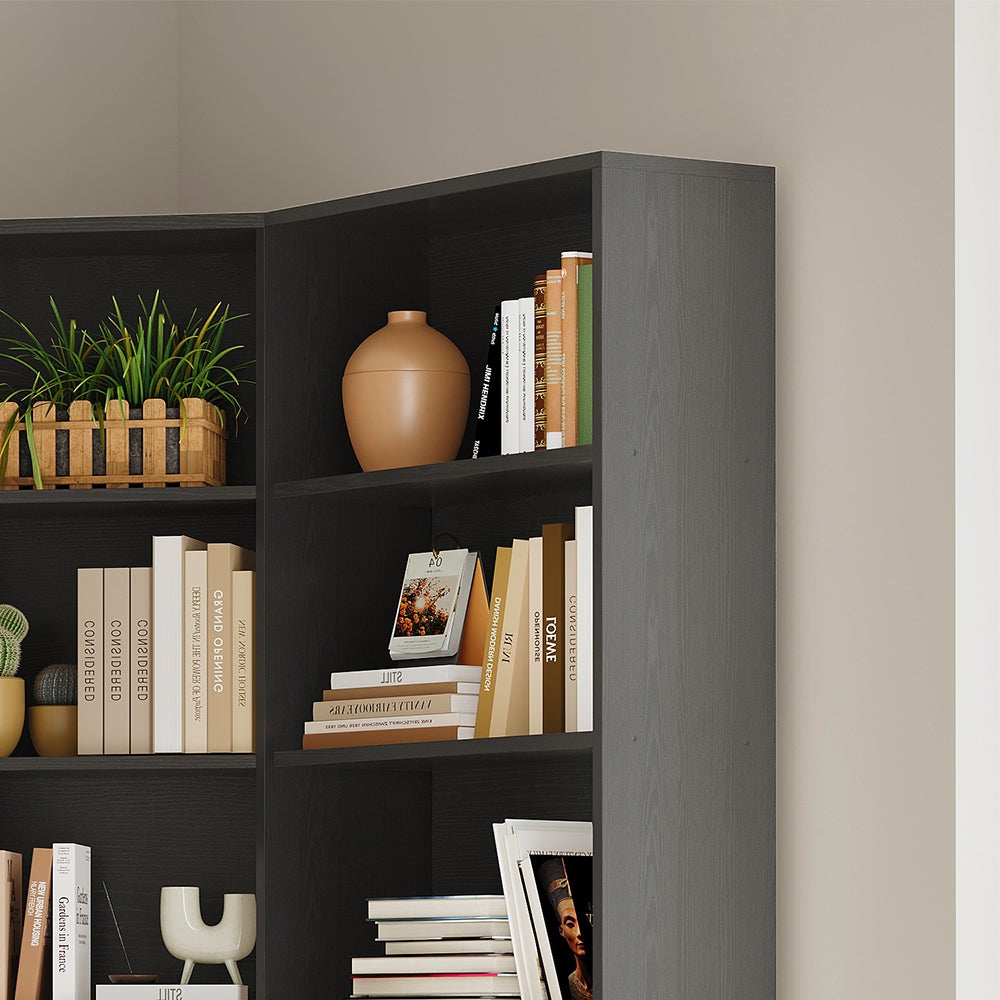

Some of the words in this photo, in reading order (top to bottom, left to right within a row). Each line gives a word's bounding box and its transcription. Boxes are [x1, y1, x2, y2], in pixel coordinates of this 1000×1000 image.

[483, 364, 492, 382] JIMI
[477, 383, 490, 420] HENDRIX
[37, 881, 47, 896] NEW
[34, 896, 45, 918] URBAN
[58, 896, 69, 932] Gardens
[30, 918, 42, 947] HOUSING
[58, 933, 69, 942] in
[58, 944, 69, 973] France
